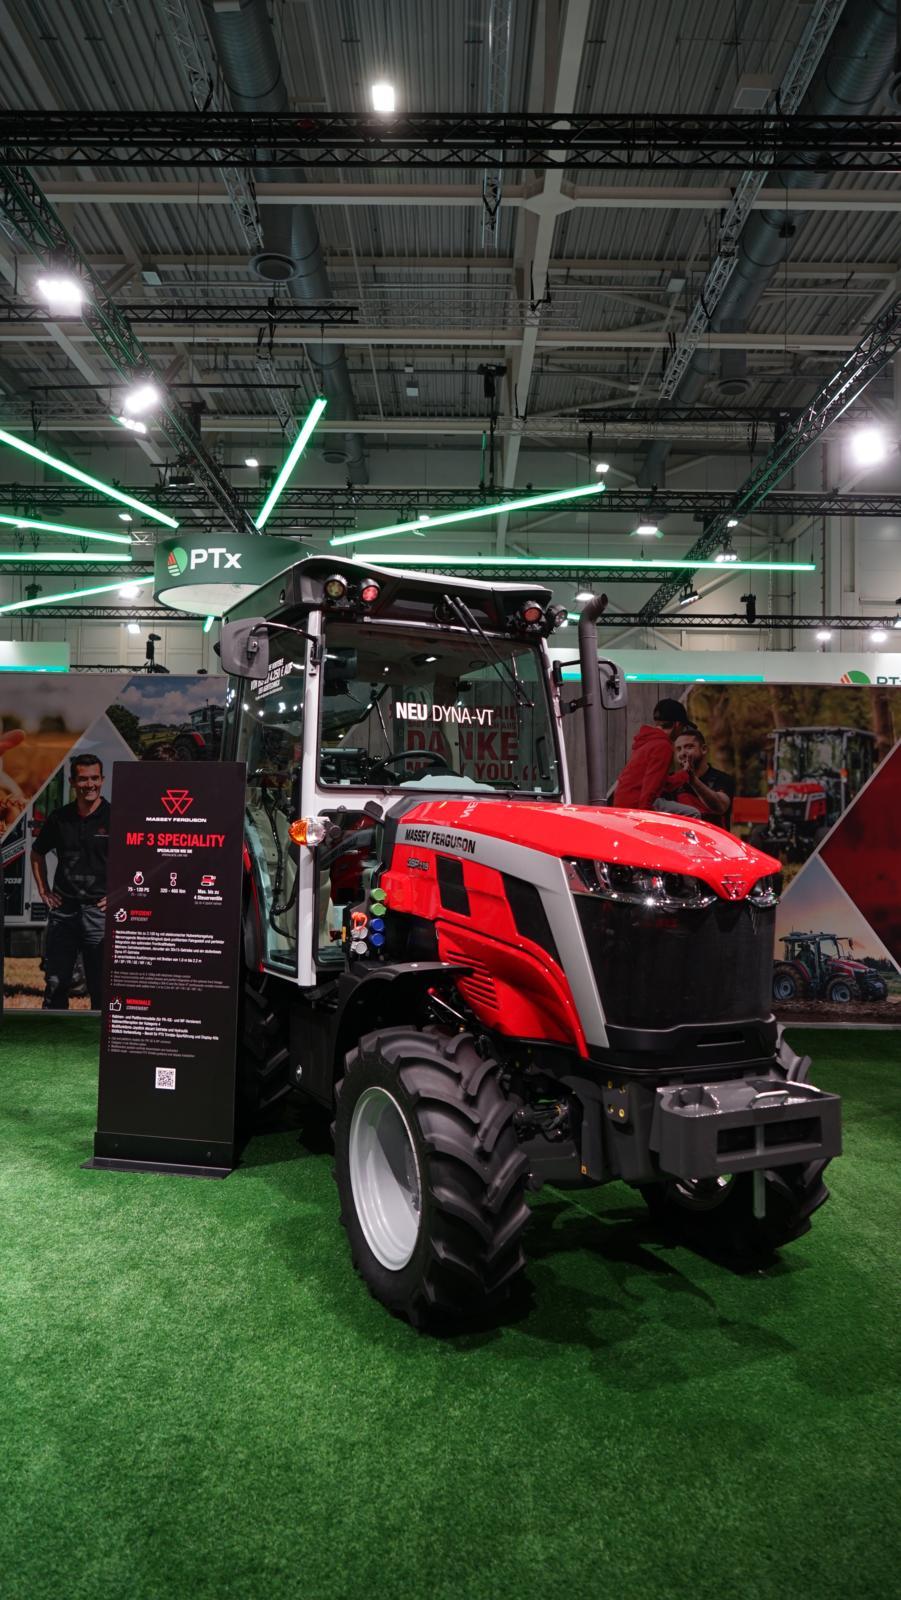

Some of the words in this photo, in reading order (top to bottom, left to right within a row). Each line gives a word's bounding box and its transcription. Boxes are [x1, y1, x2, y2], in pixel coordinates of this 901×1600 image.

[190, 548, 242, 570] PTx
[876, 676, 901, 685] PT
[396, 702, 428, 720] NEU
[432, 704, 494, 726] DYNA-VT
[126, 832, 144, 846] MF
[146, 832, 155, 846] 3
[157, 833, 225, 848] SPECIALITY
[404, 828, 430, 844] MASSEY
[431, 832, 476, 854] FERGUSON
